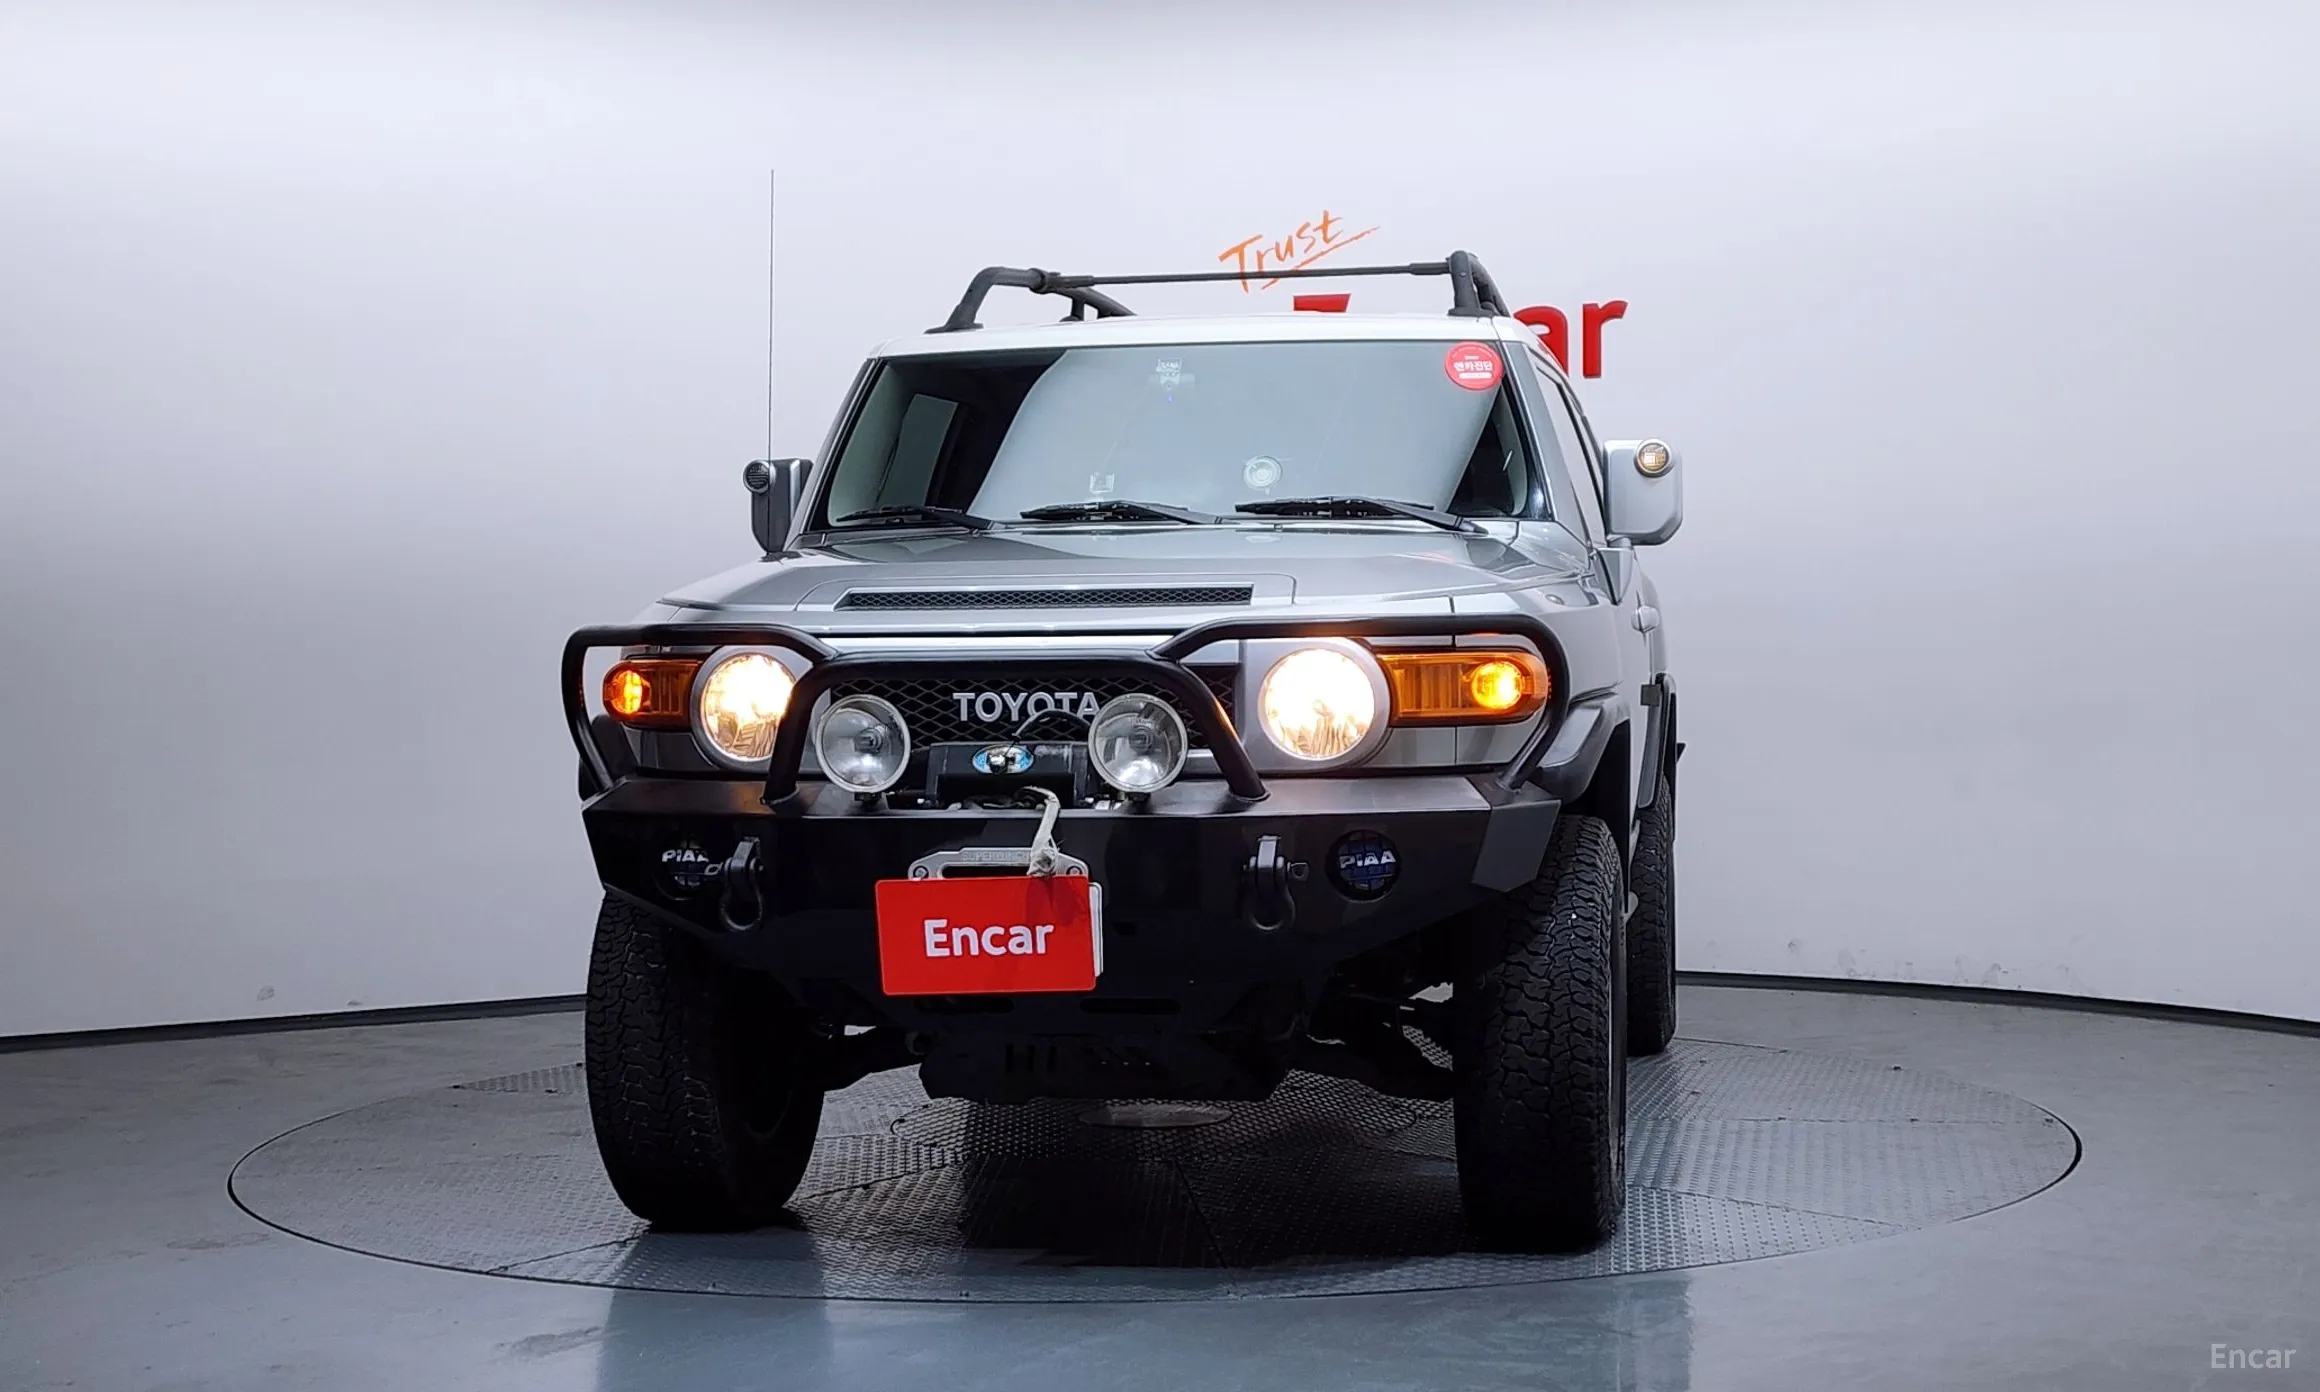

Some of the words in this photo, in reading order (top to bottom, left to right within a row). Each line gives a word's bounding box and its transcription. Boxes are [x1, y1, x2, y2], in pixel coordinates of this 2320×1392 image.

[1218, 210, 1344, 293] Trust
[953, 691, 1100, 723] TOYOTA
[923, 918, 1055, 957] Encar
